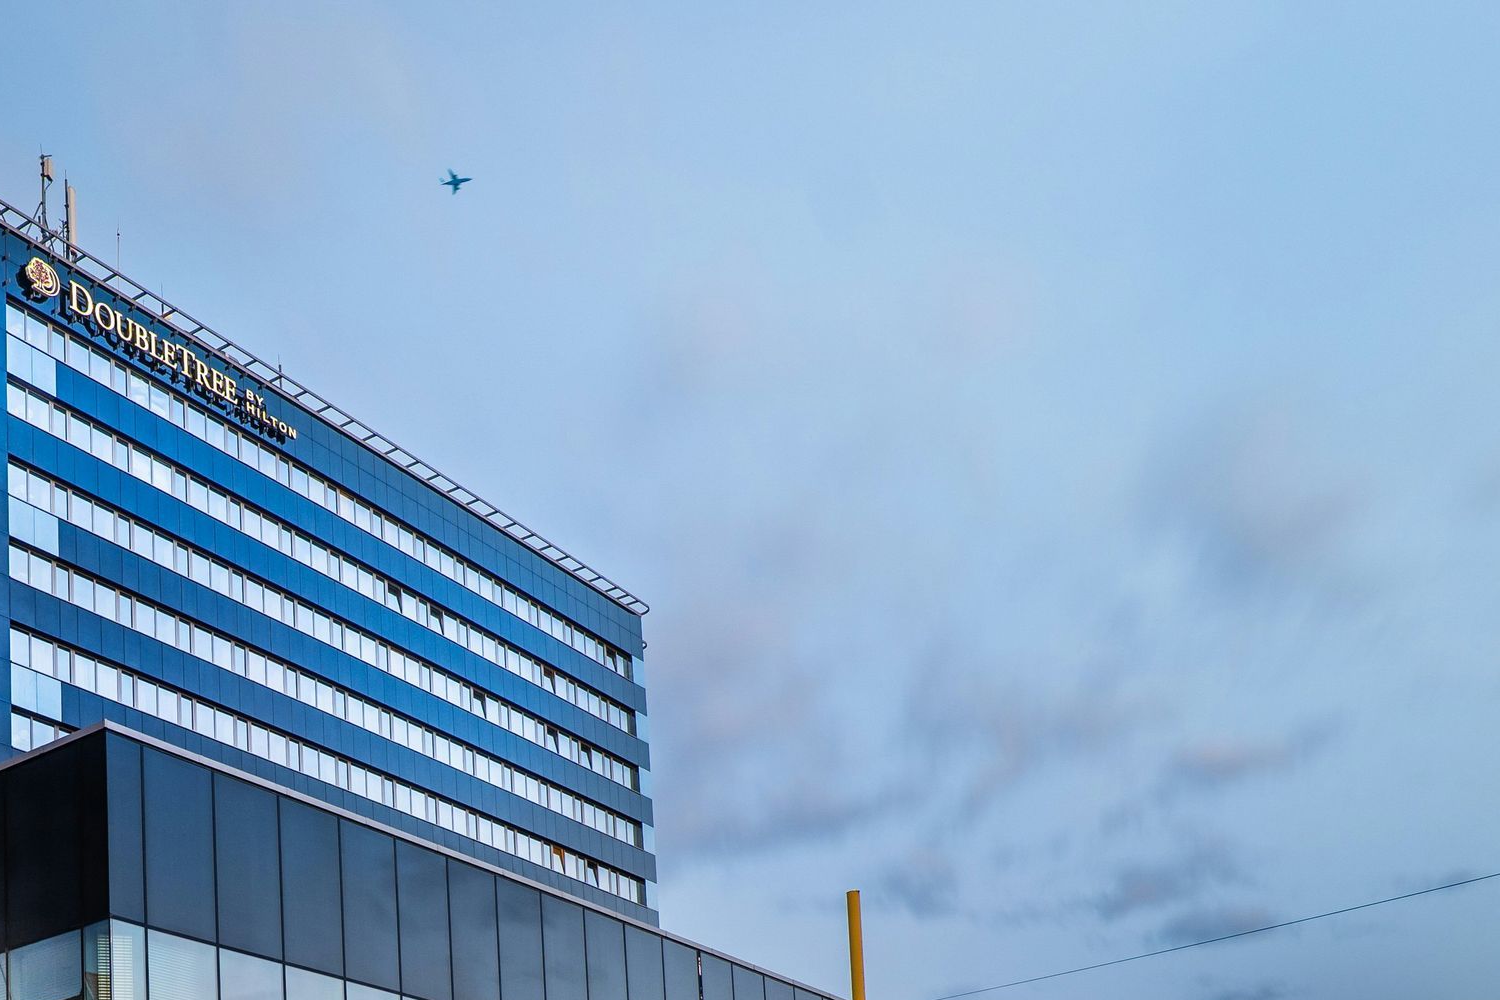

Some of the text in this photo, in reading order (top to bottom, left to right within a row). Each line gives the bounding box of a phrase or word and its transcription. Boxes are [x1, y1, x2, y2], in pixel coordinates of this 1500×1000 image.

[69, 279, 238, 406] DOUBLETREE
[246, 389, 264, 405] BY
[246, 403, 297, 440] HILTON
